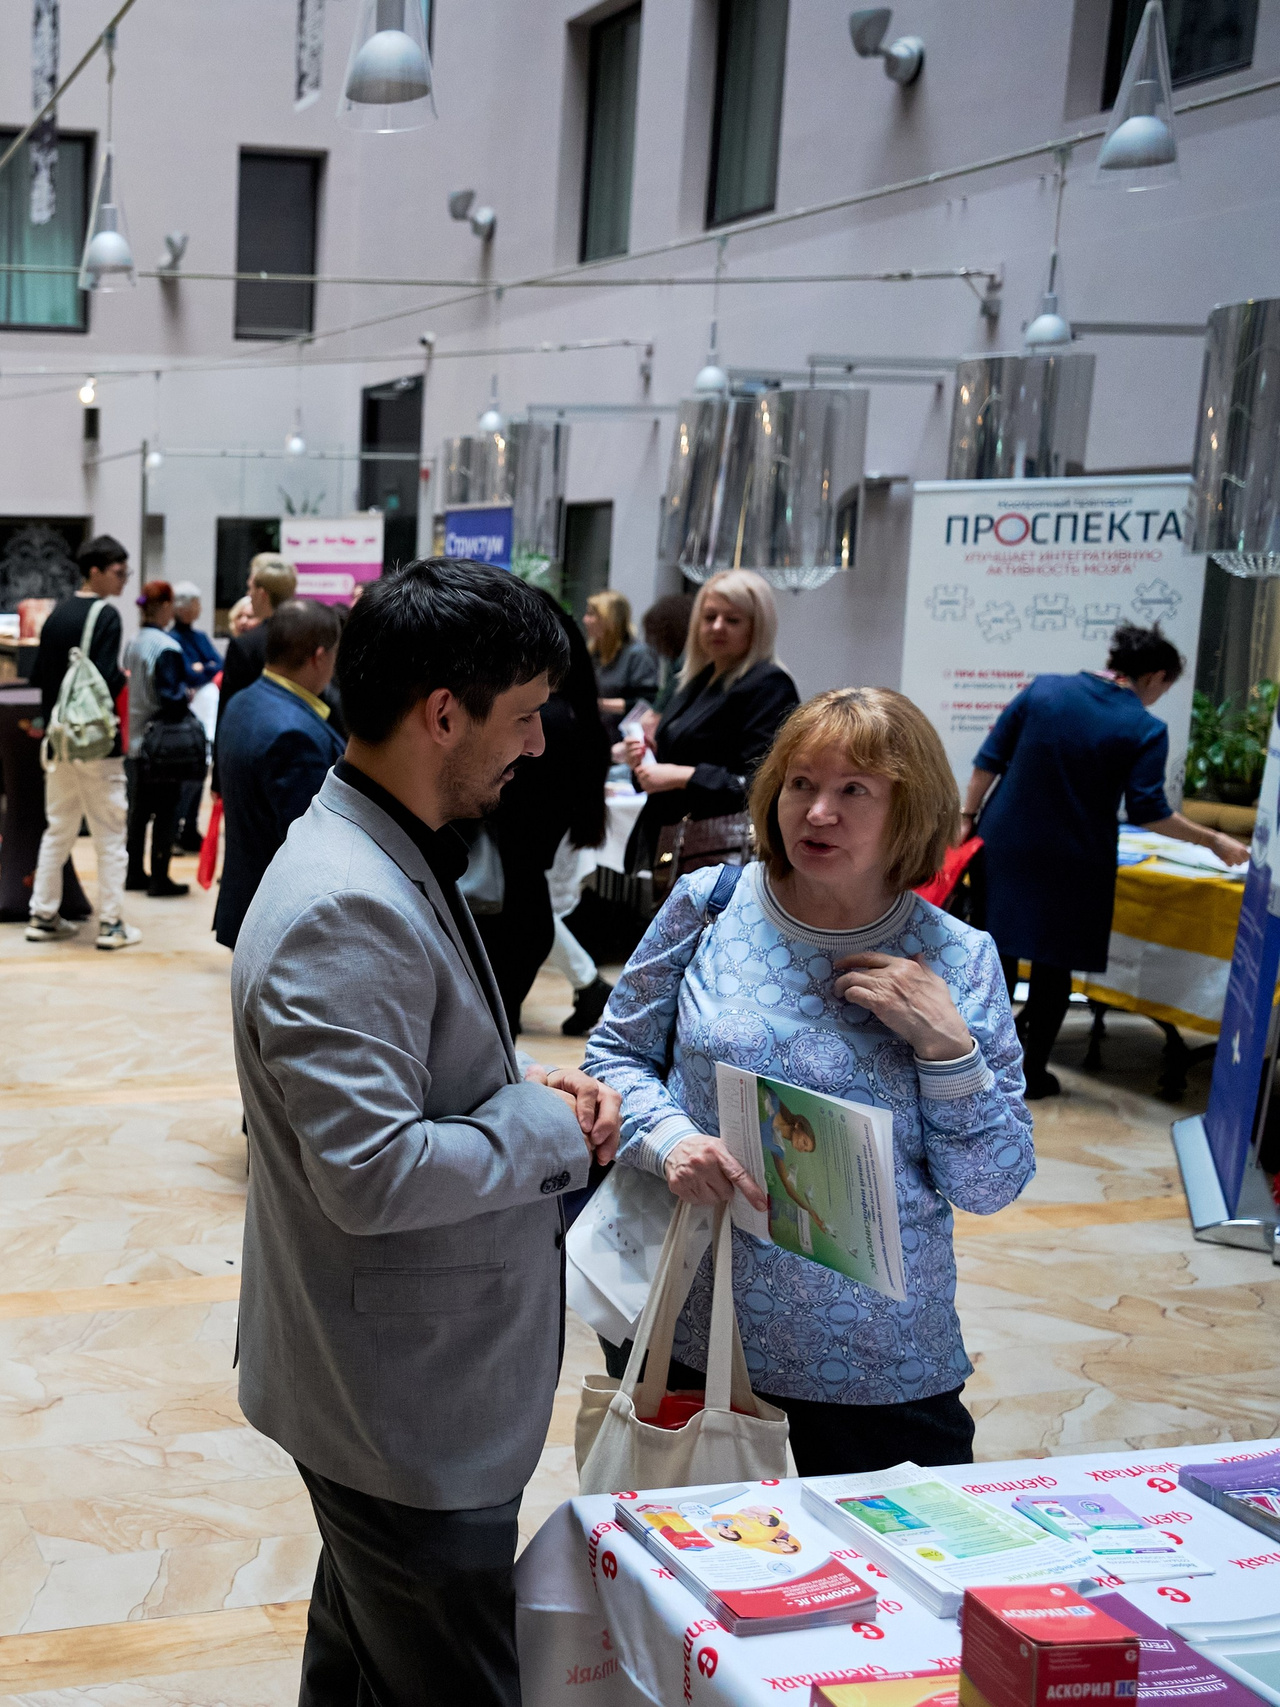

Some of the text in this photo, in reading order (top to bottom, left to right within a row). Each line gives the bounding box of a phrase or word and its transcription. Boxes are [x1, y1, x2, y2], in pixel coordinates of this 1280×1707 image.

[945, 509, 1183, 547] ПРОСПЕКТА
[1038, 549, 1163, 563] ИНТЕГРАТИВНУЮ
[985, 564, 1080, 577] АКТИВНОСТЬ
[810, 1585, 862, 1606] АСКОРИЛ
[1001, 1607, 1070, 1619] АСКОРИЛ
[1046, 1682, 1111, 1700] АСКОРИЛ
[1115, 1680, 1136, 1697] ЛС
